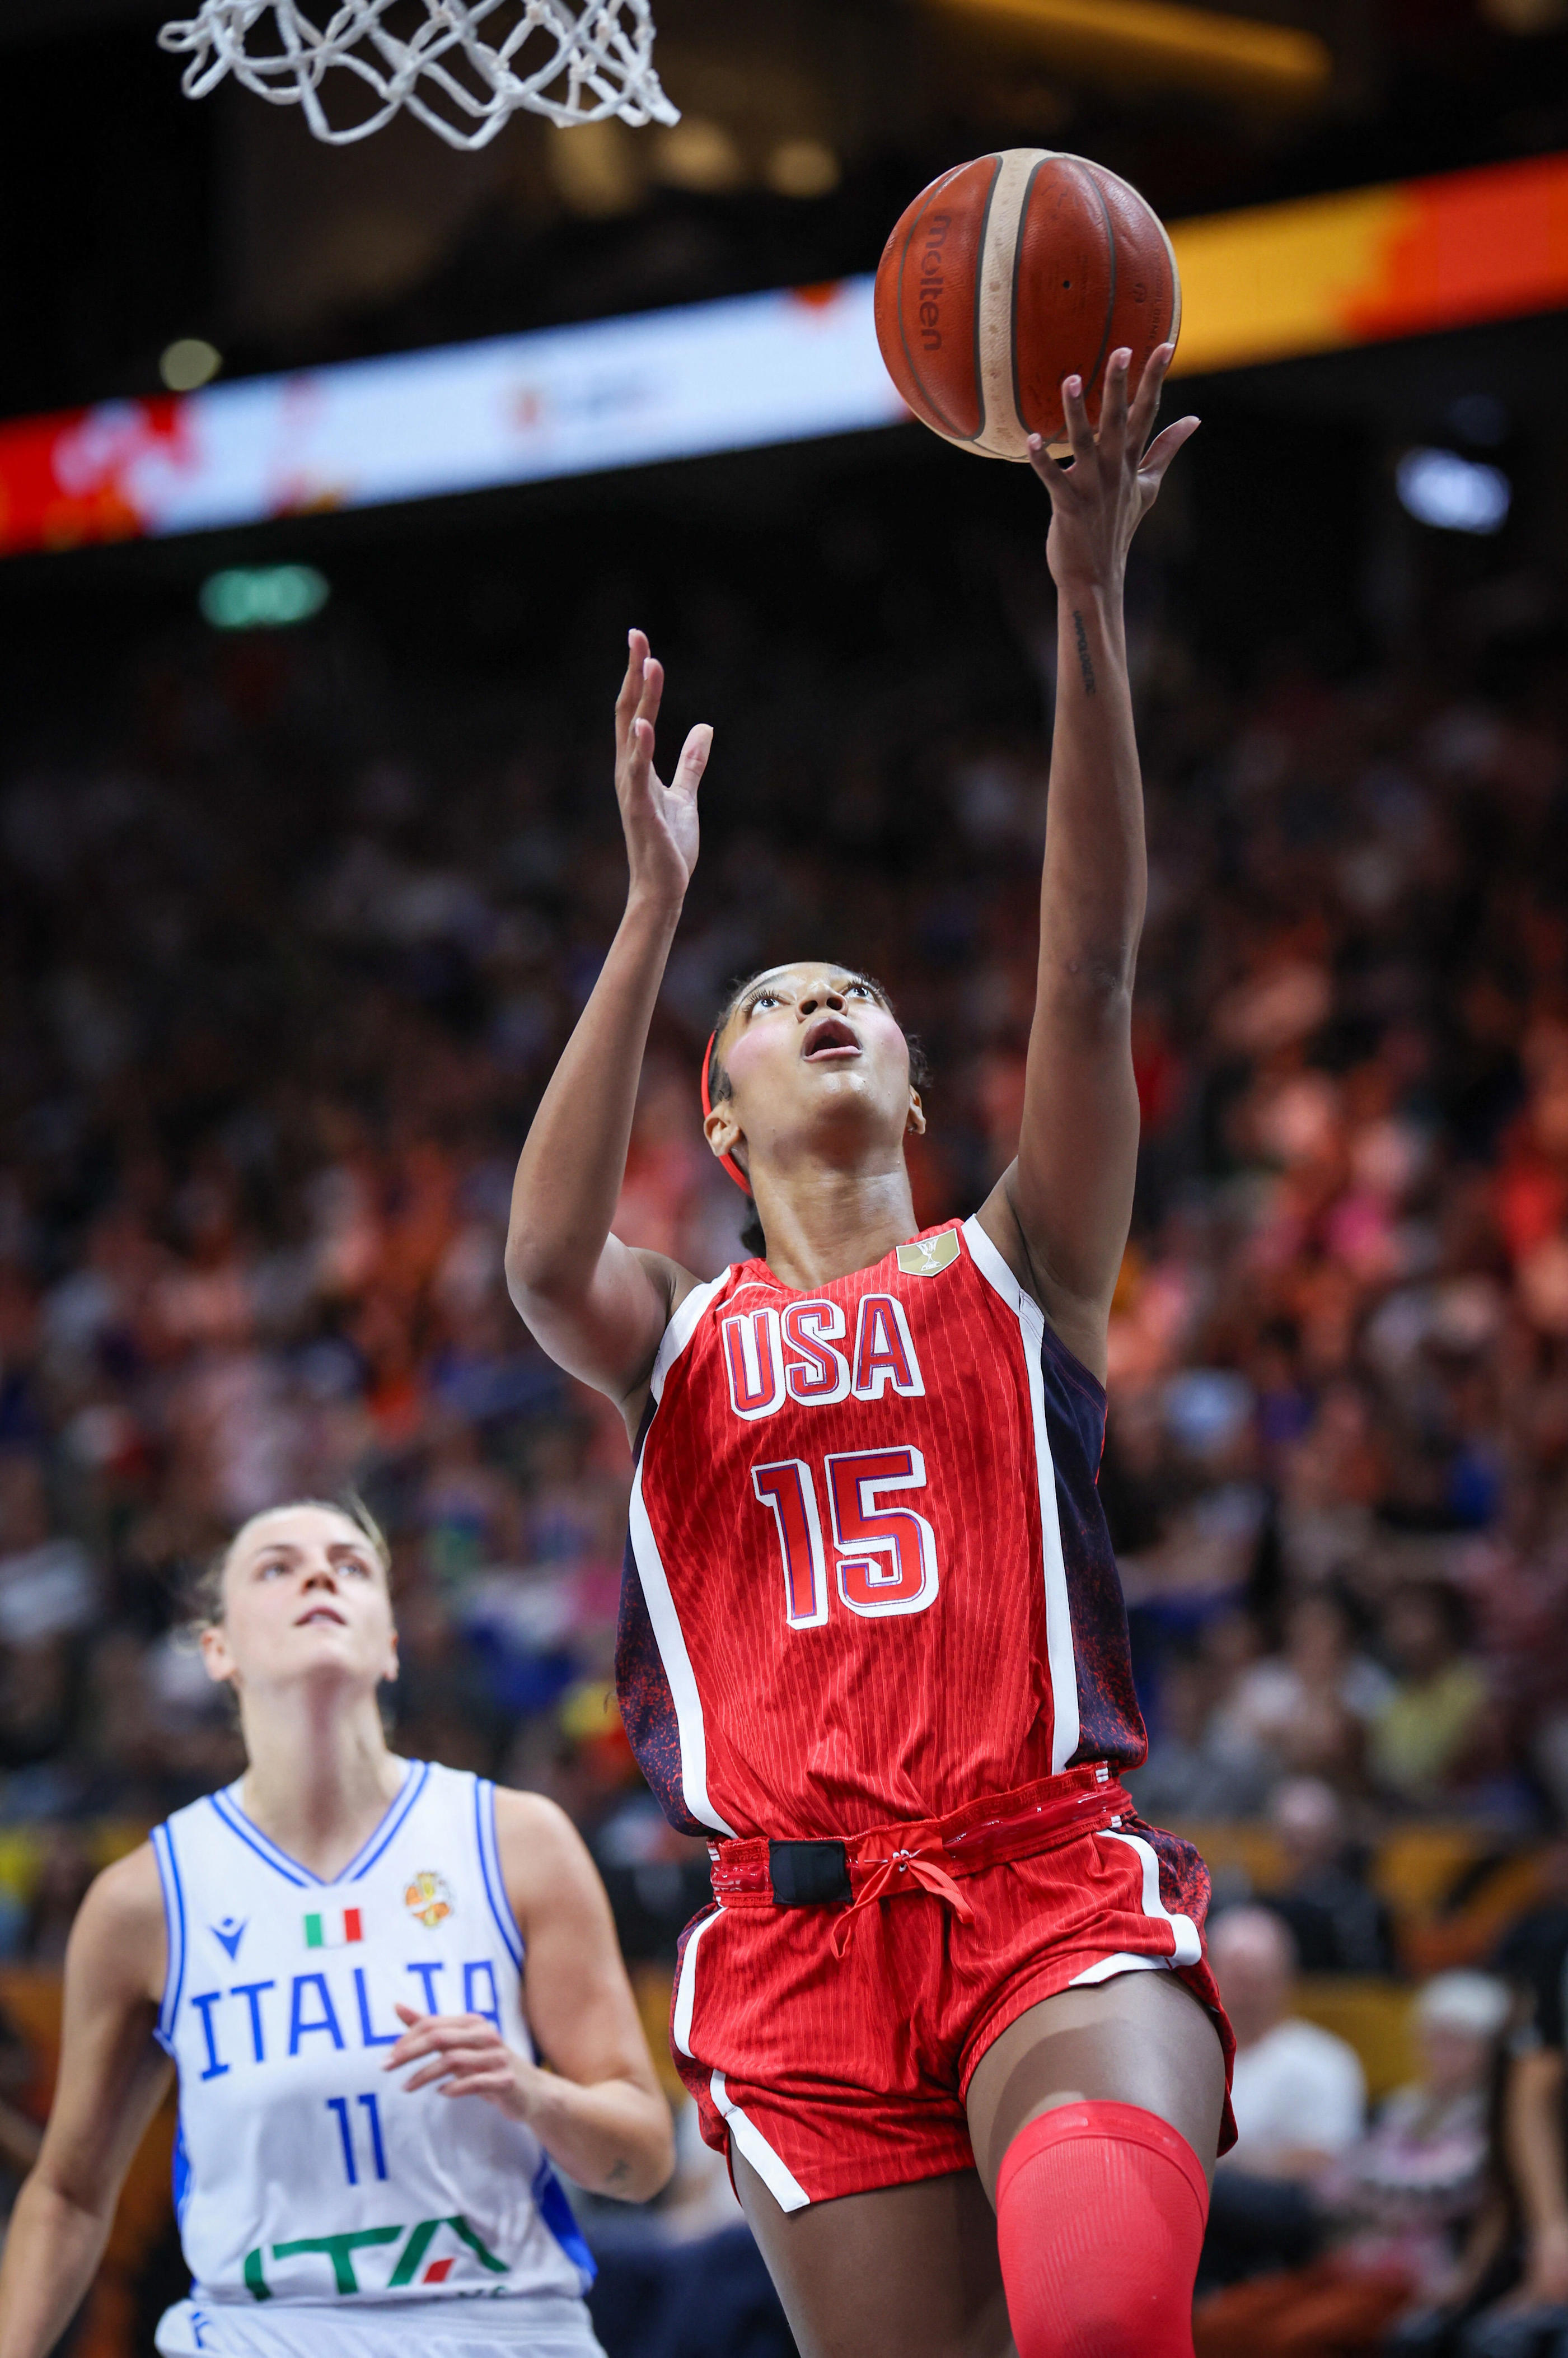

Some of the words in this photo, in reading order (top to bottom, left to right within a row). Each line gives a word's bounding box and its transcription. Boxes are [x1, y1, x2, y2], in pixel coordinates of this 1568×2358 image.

[919, 215, 952, 351] molten
[722, 1294, 926, 1422] USA
[751, 1444, 940, 1631] 15
[191, 1961, 503, 2083] ITALIA
[326, 2093, 388, 2186] 11
[244, 2215, 511, 2303] ITA
